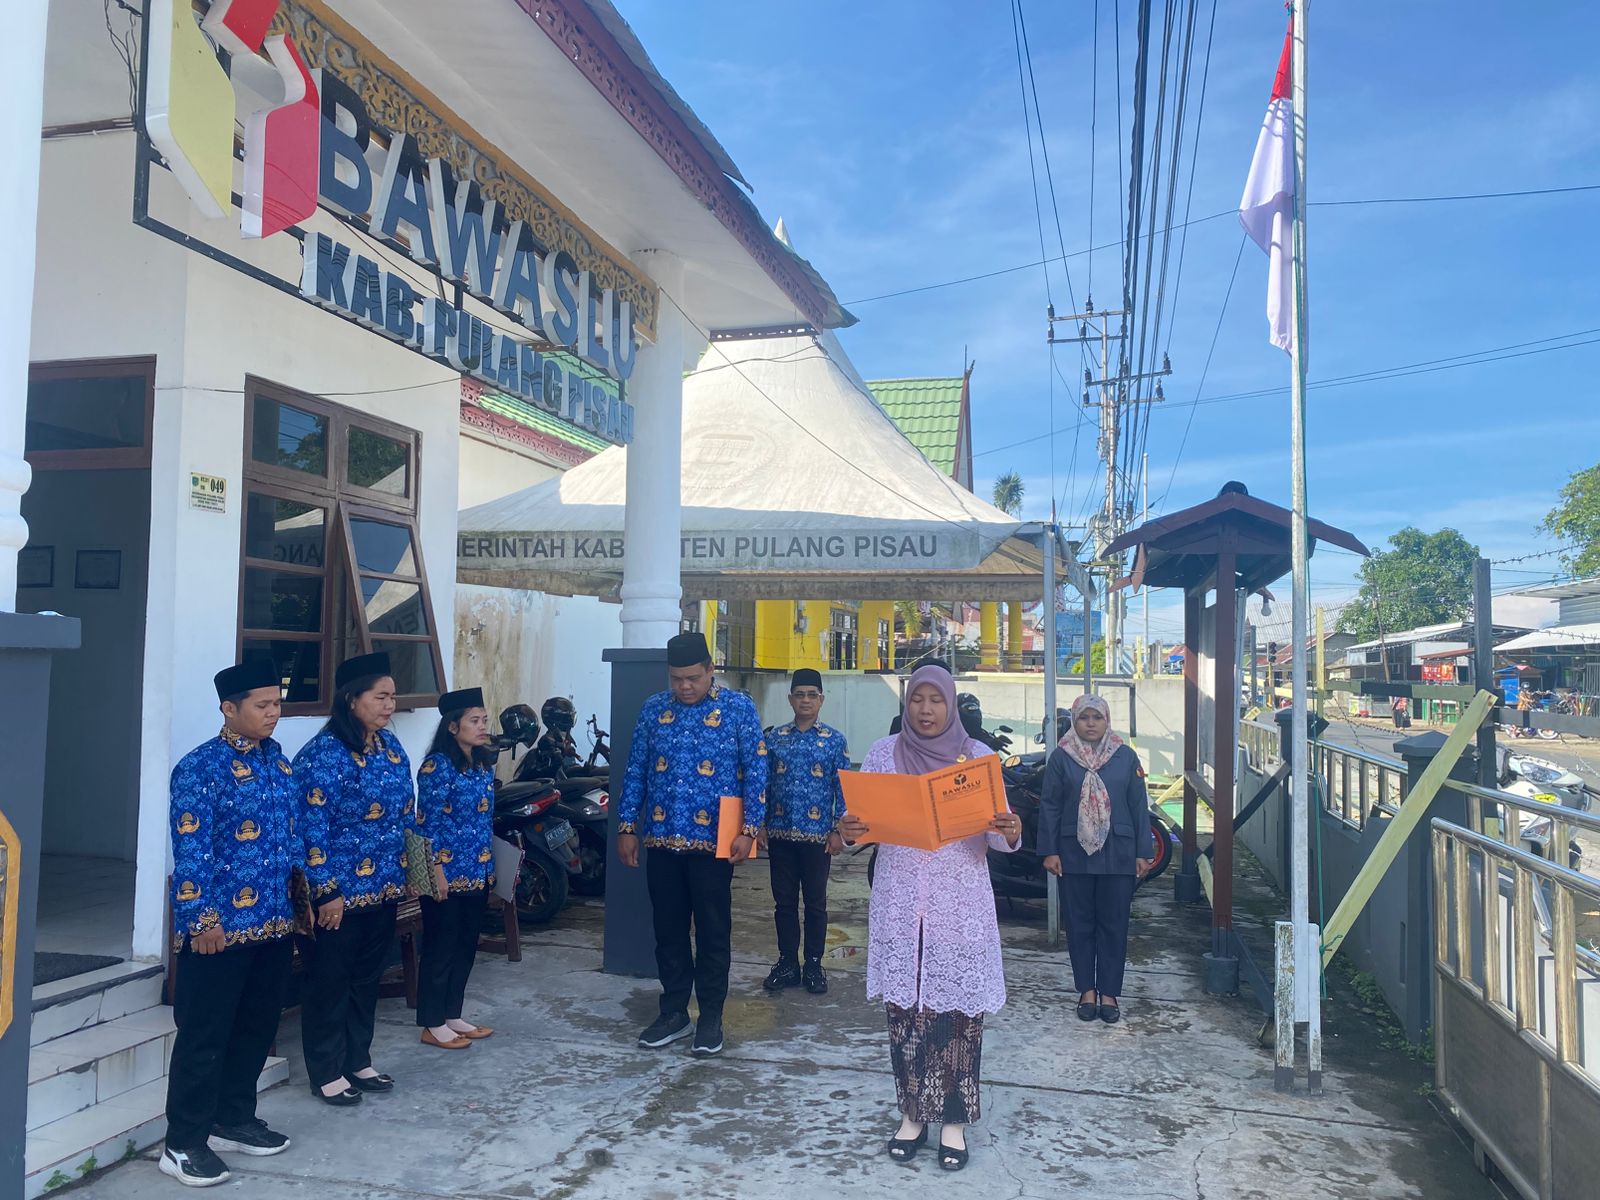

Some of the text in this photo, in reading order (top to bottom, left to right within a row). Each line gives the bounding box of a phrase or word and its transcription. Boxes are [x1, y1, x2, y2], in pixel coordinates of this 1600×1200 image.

[317, 67, 636, 380] BAWASLU
[303, 231, 635, 444] KAB. PULANG PISAU
[210, 478, 225, 494] 049
[735, 535, 845, 558] PULANG
[854, 535, 938, 558] PISAU
[943, 780, 981, 796] BAWASLU
